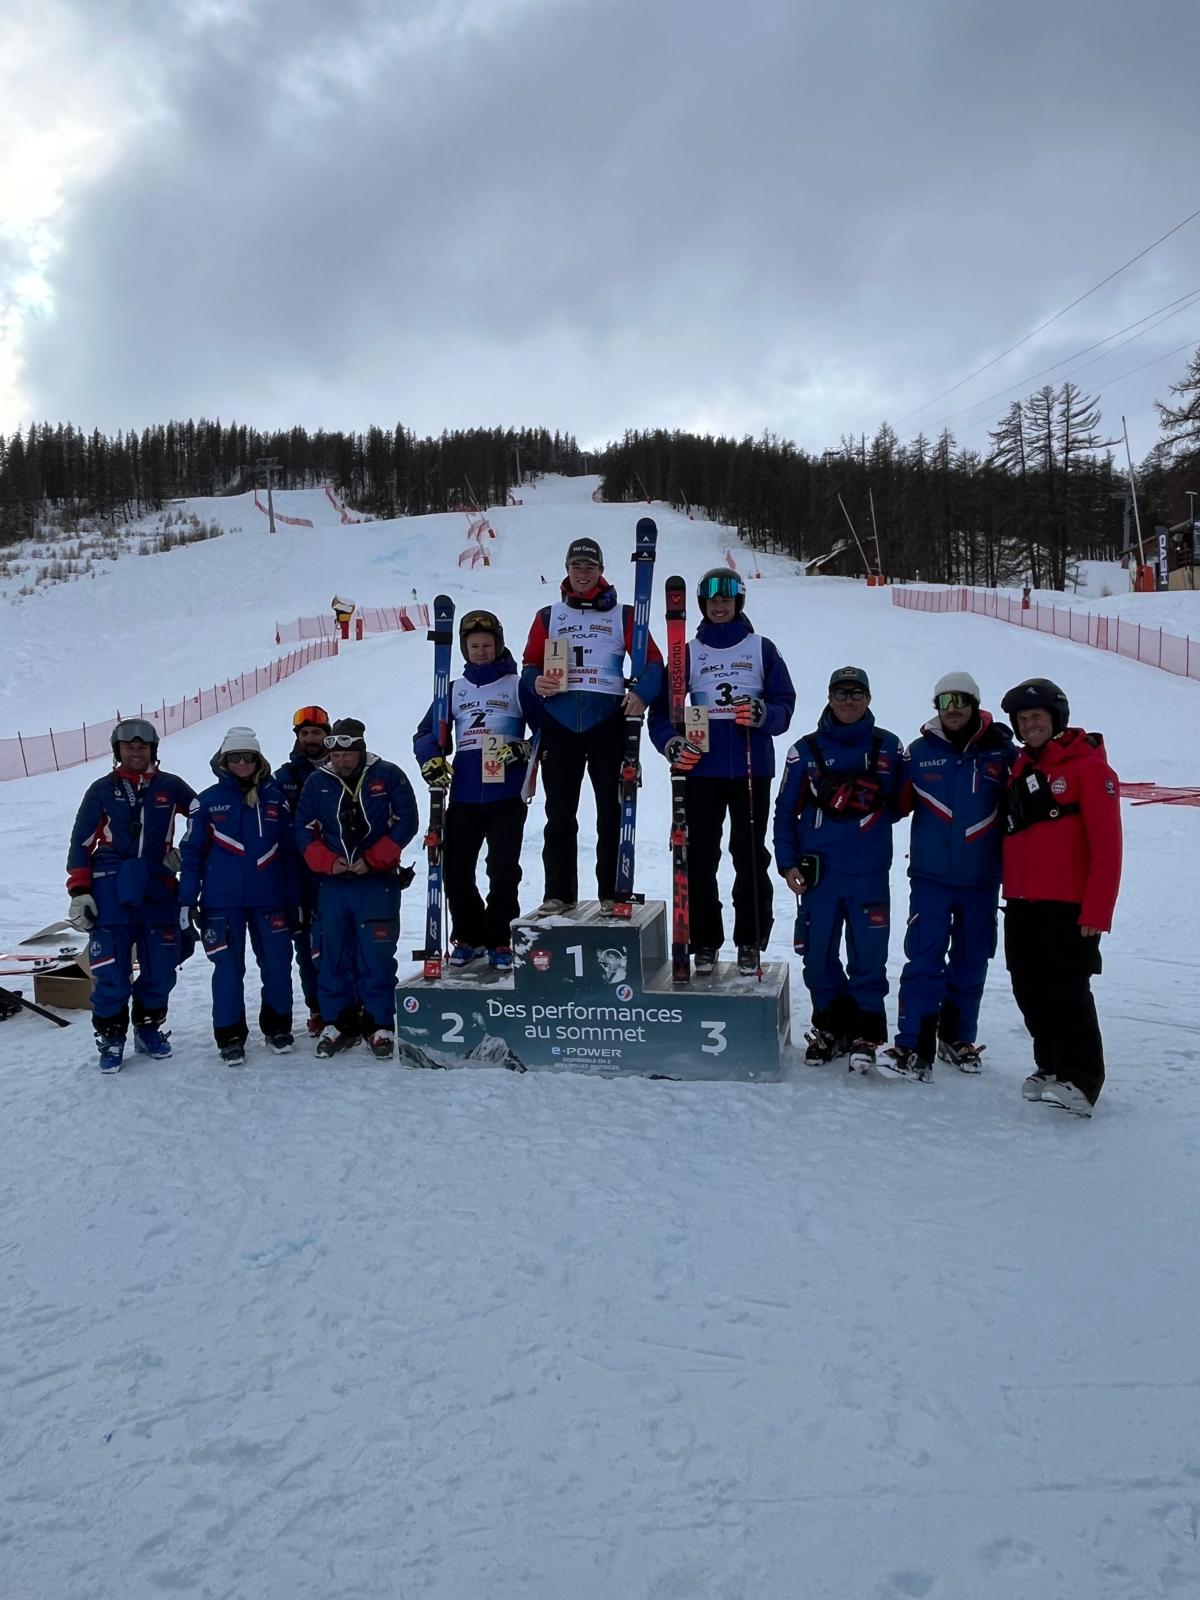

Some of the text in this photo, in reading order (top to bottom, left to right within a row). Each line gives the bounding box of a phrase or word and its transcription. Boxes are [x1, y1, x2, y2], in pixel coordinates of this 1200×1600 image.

[558, 625, 583, 635] SKI
[551, 641, 559, 657] 1
[672, 639, 683, 695] ROSSIGNOL
[700, 664, 724, 675] SKI
[714, 671, 739, 679] TOUR
[459, 701, 480, 711] SKI
[692, 708, 701, 722] 3
[463, 728, 492, 737] HOMME
[488, 737, 498, 751] 2
[566, 945, 584, 977] 1
[488, 1000, 683, 1023] Des performances
[441, 1012, 465, 1043] 2
[524, 1025, 647, 1042] au sommet
[701, 1021, 727, 1054] 3
